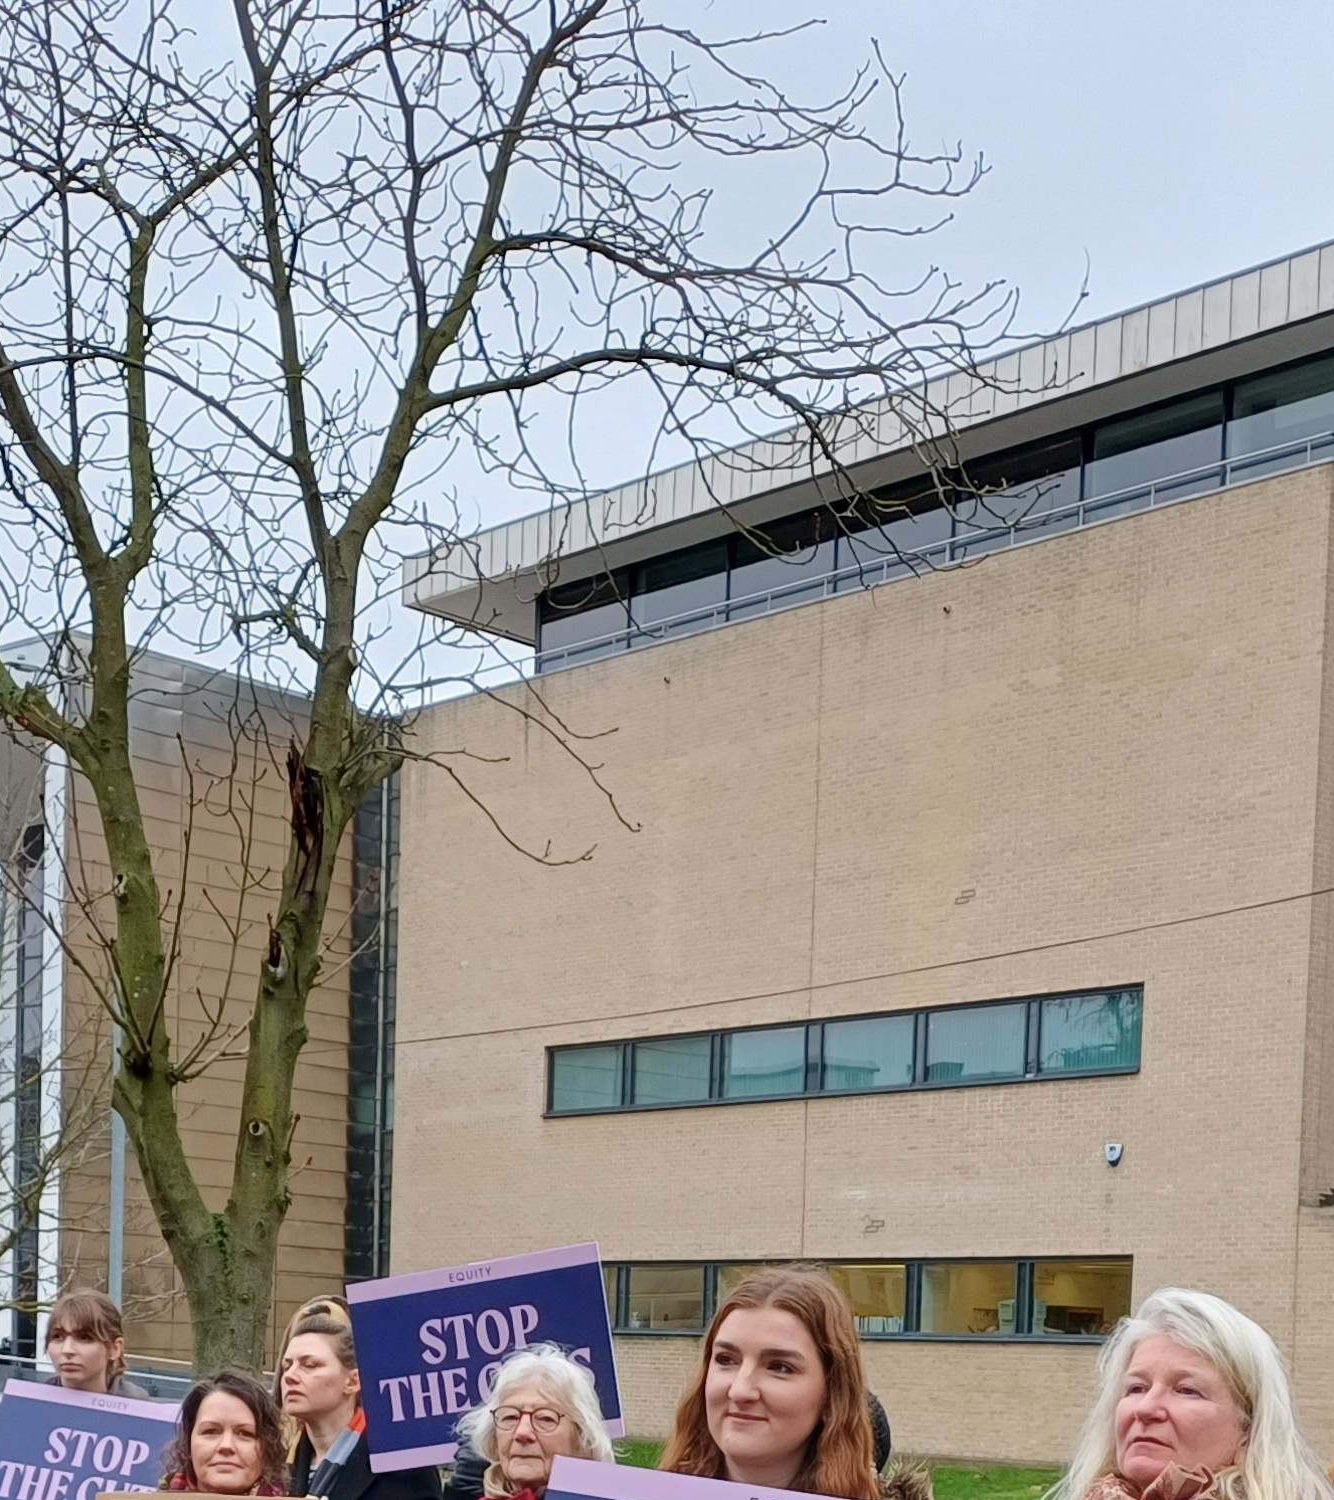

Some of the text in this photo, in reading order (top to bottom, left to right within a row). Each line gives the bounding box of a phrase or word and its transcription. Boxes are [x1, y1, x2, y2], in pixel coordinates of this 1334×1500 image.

[448, 1266, 492, 1283] EQUITY
[419, 1304, 539, 1365] STOP
[91, 1397, 129, 1411] EQUITY
[378, 1367, 471, 1422] THE
[44, 1427, 150, 1476] STOP
